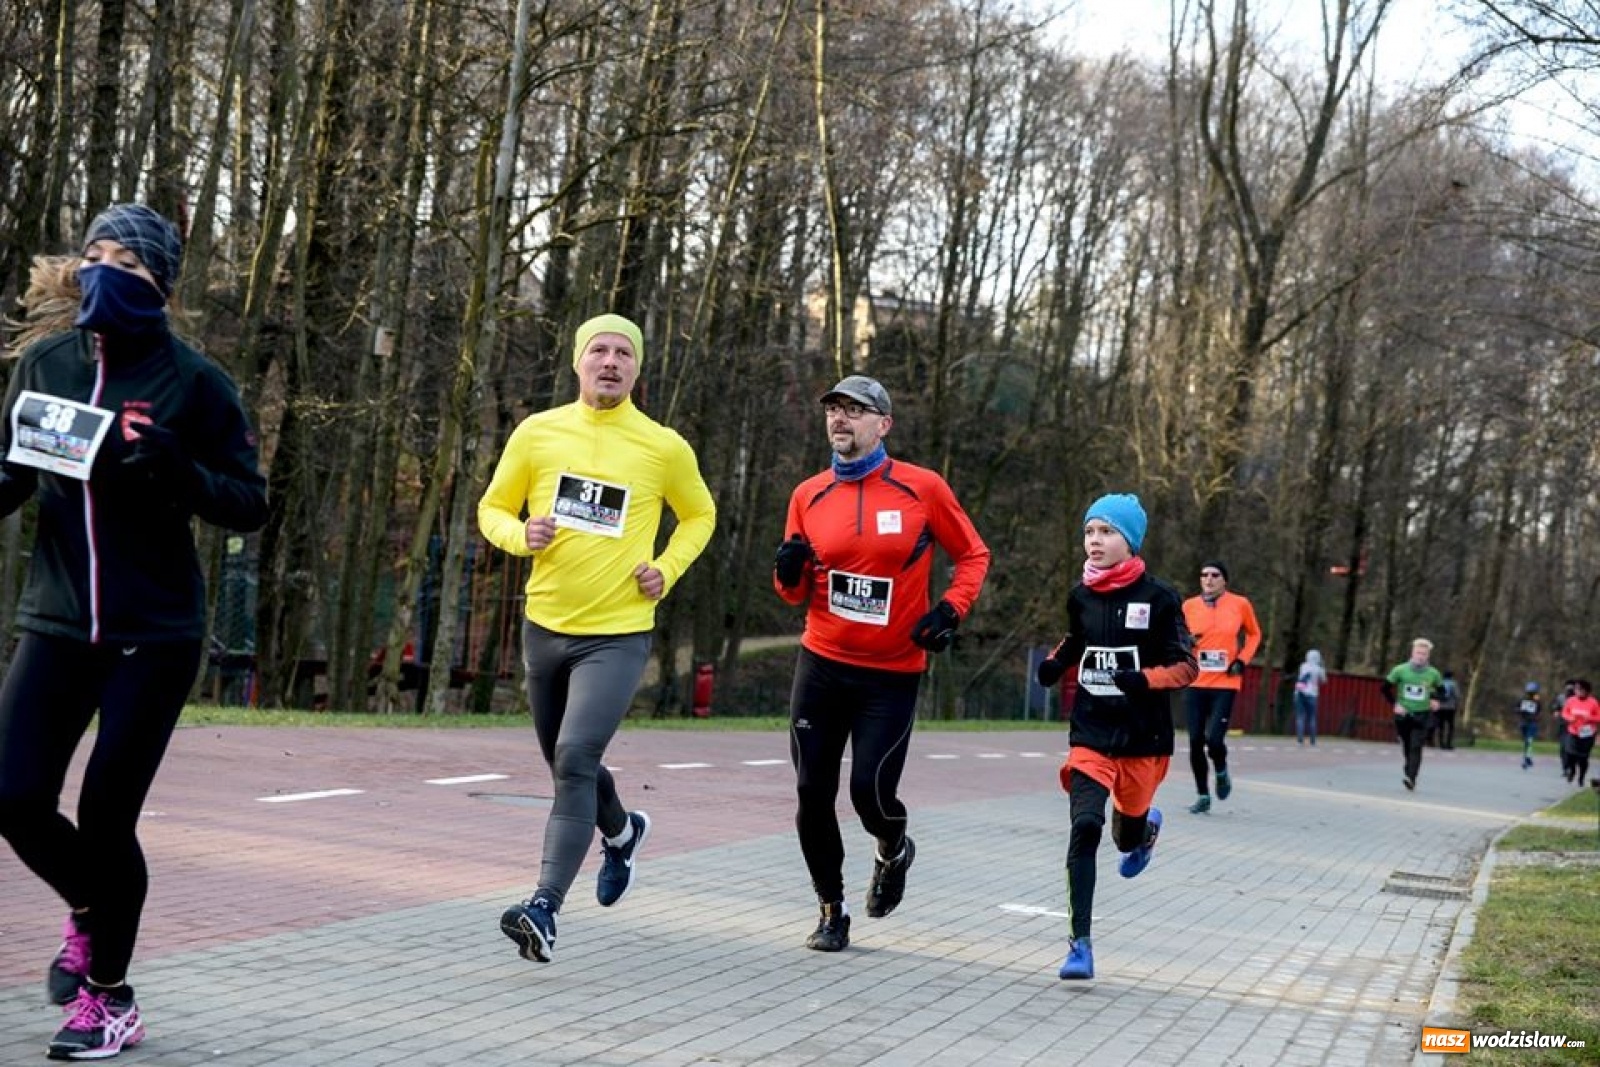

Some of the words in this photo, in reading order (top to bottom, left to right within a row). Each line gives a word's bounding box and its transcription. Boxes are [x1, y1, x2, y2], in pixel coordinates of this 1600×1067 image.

[41, 403, 76, 433] 38
[580, 481, 603, 504] 31
[847, 577, 873, 598] 115
[1094, 651, 1118, 670] 114
